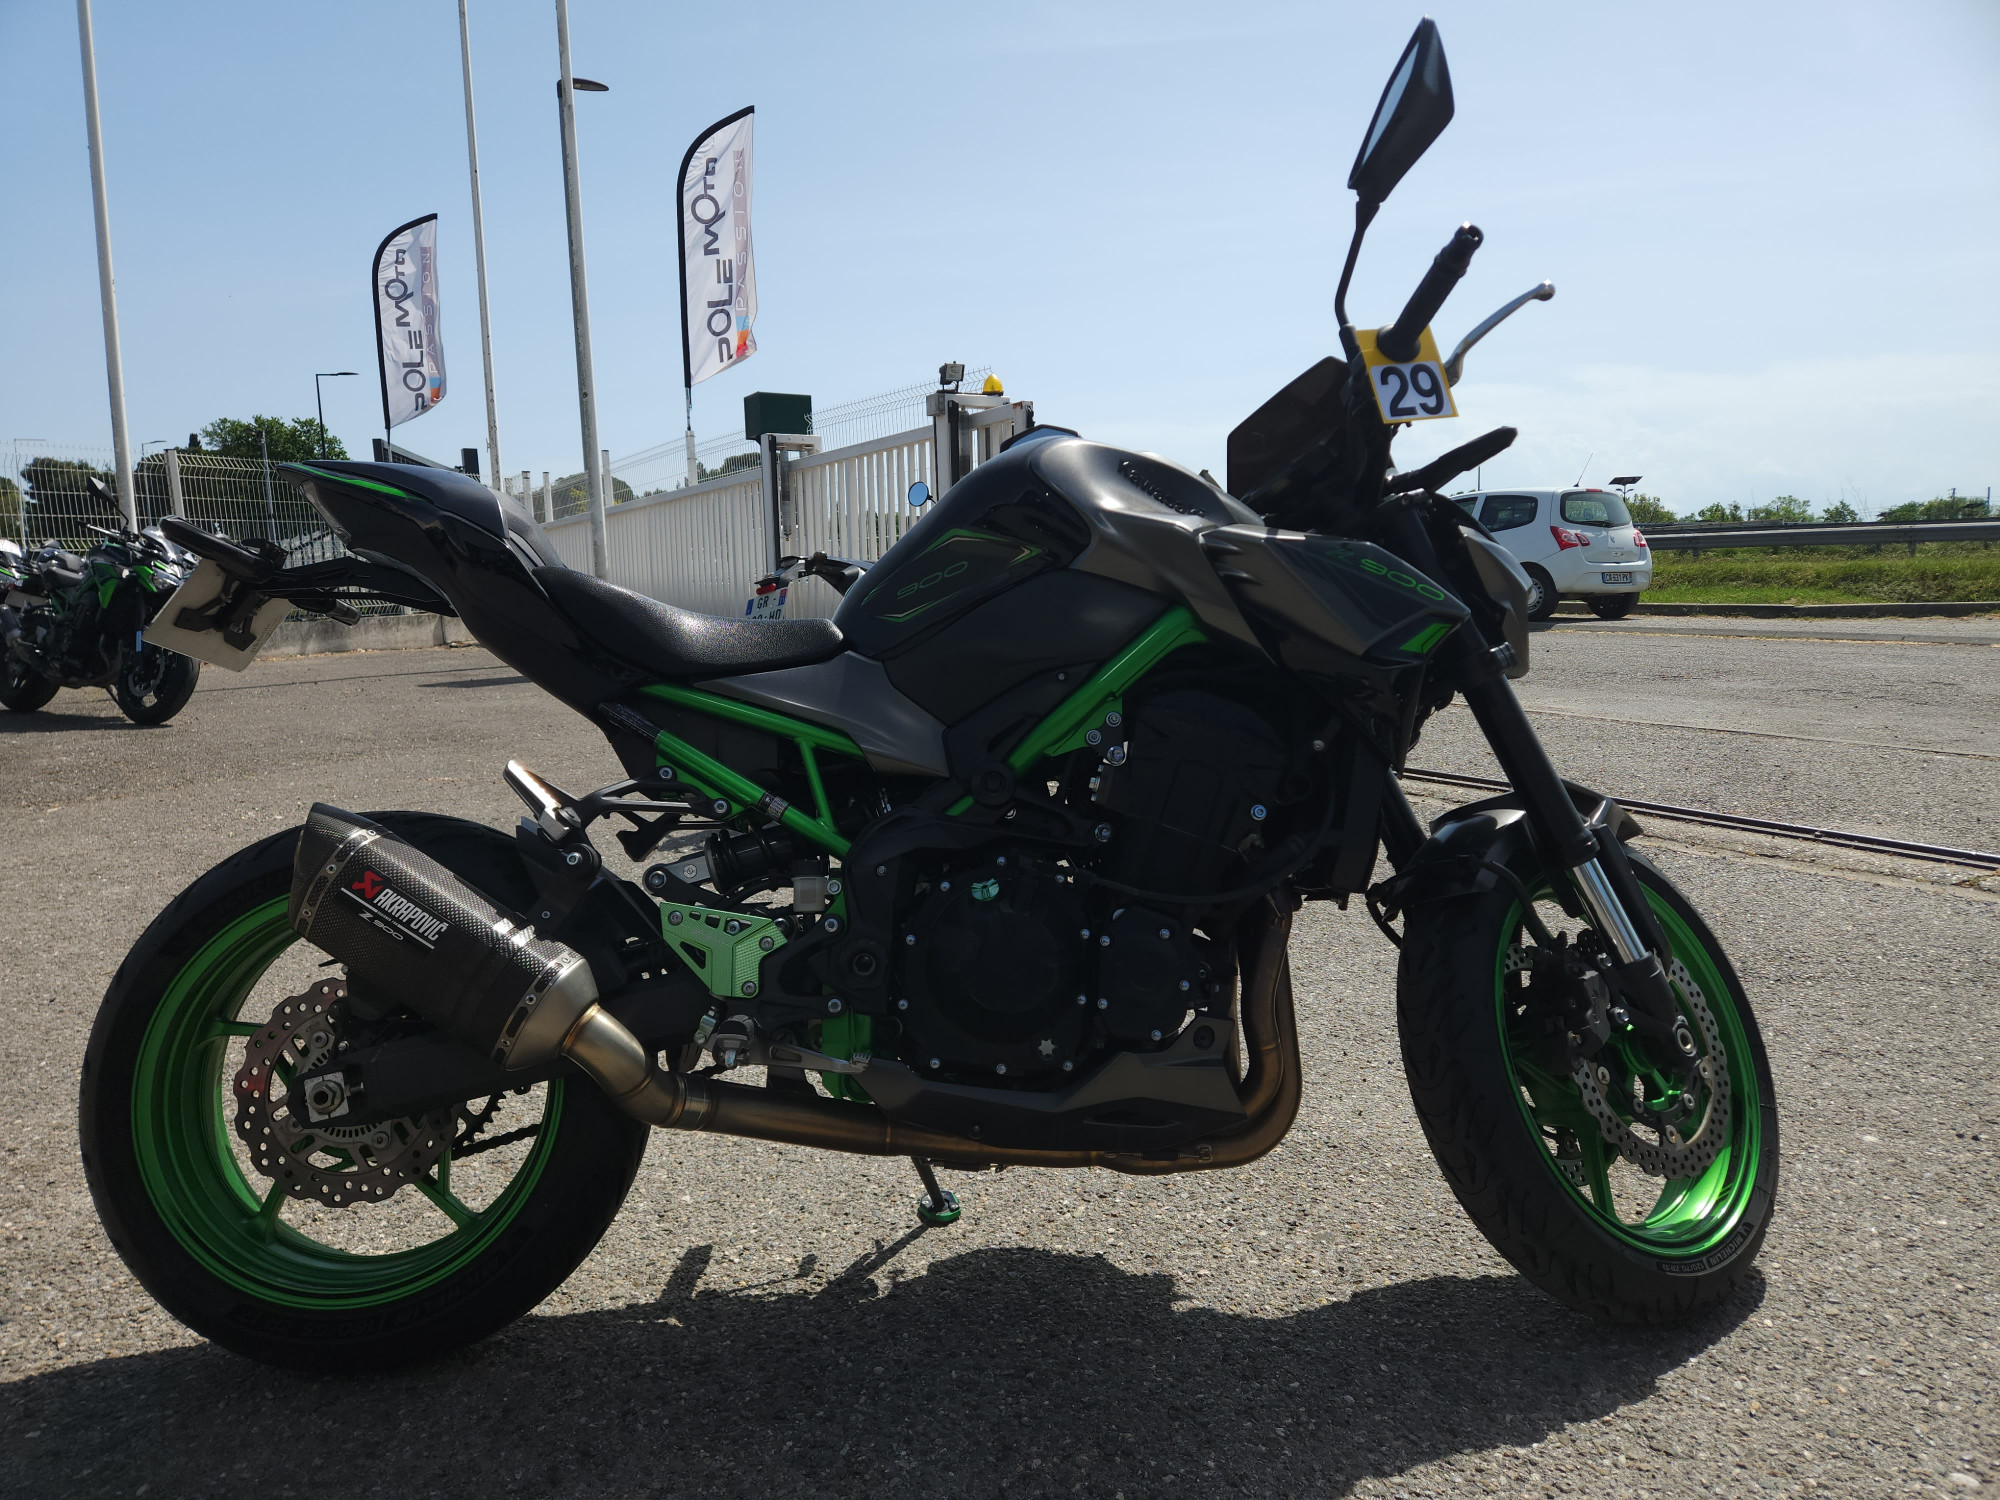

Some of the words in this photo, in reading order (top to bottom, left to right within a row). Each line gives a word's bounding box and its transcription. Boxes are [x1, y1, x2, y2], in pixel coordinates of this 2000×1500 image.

[691, 158, 726, 256] MOTO
[384, 248, 414, 328] MOTO
[422, 252, 438, 374] PASSION
[707, 259, 733, 362] POLE
[402, 330, 427, 412] POLE
[1380, 364, 1444, 416] 29
[897, 560, 968, 600] 900
[1360, 558, 1444, 600] 900
[358, 908, 374, 922] Z
[373, 920, 404, 940] 900
[1710, 1232, 1744, 1266] MICHELIN
